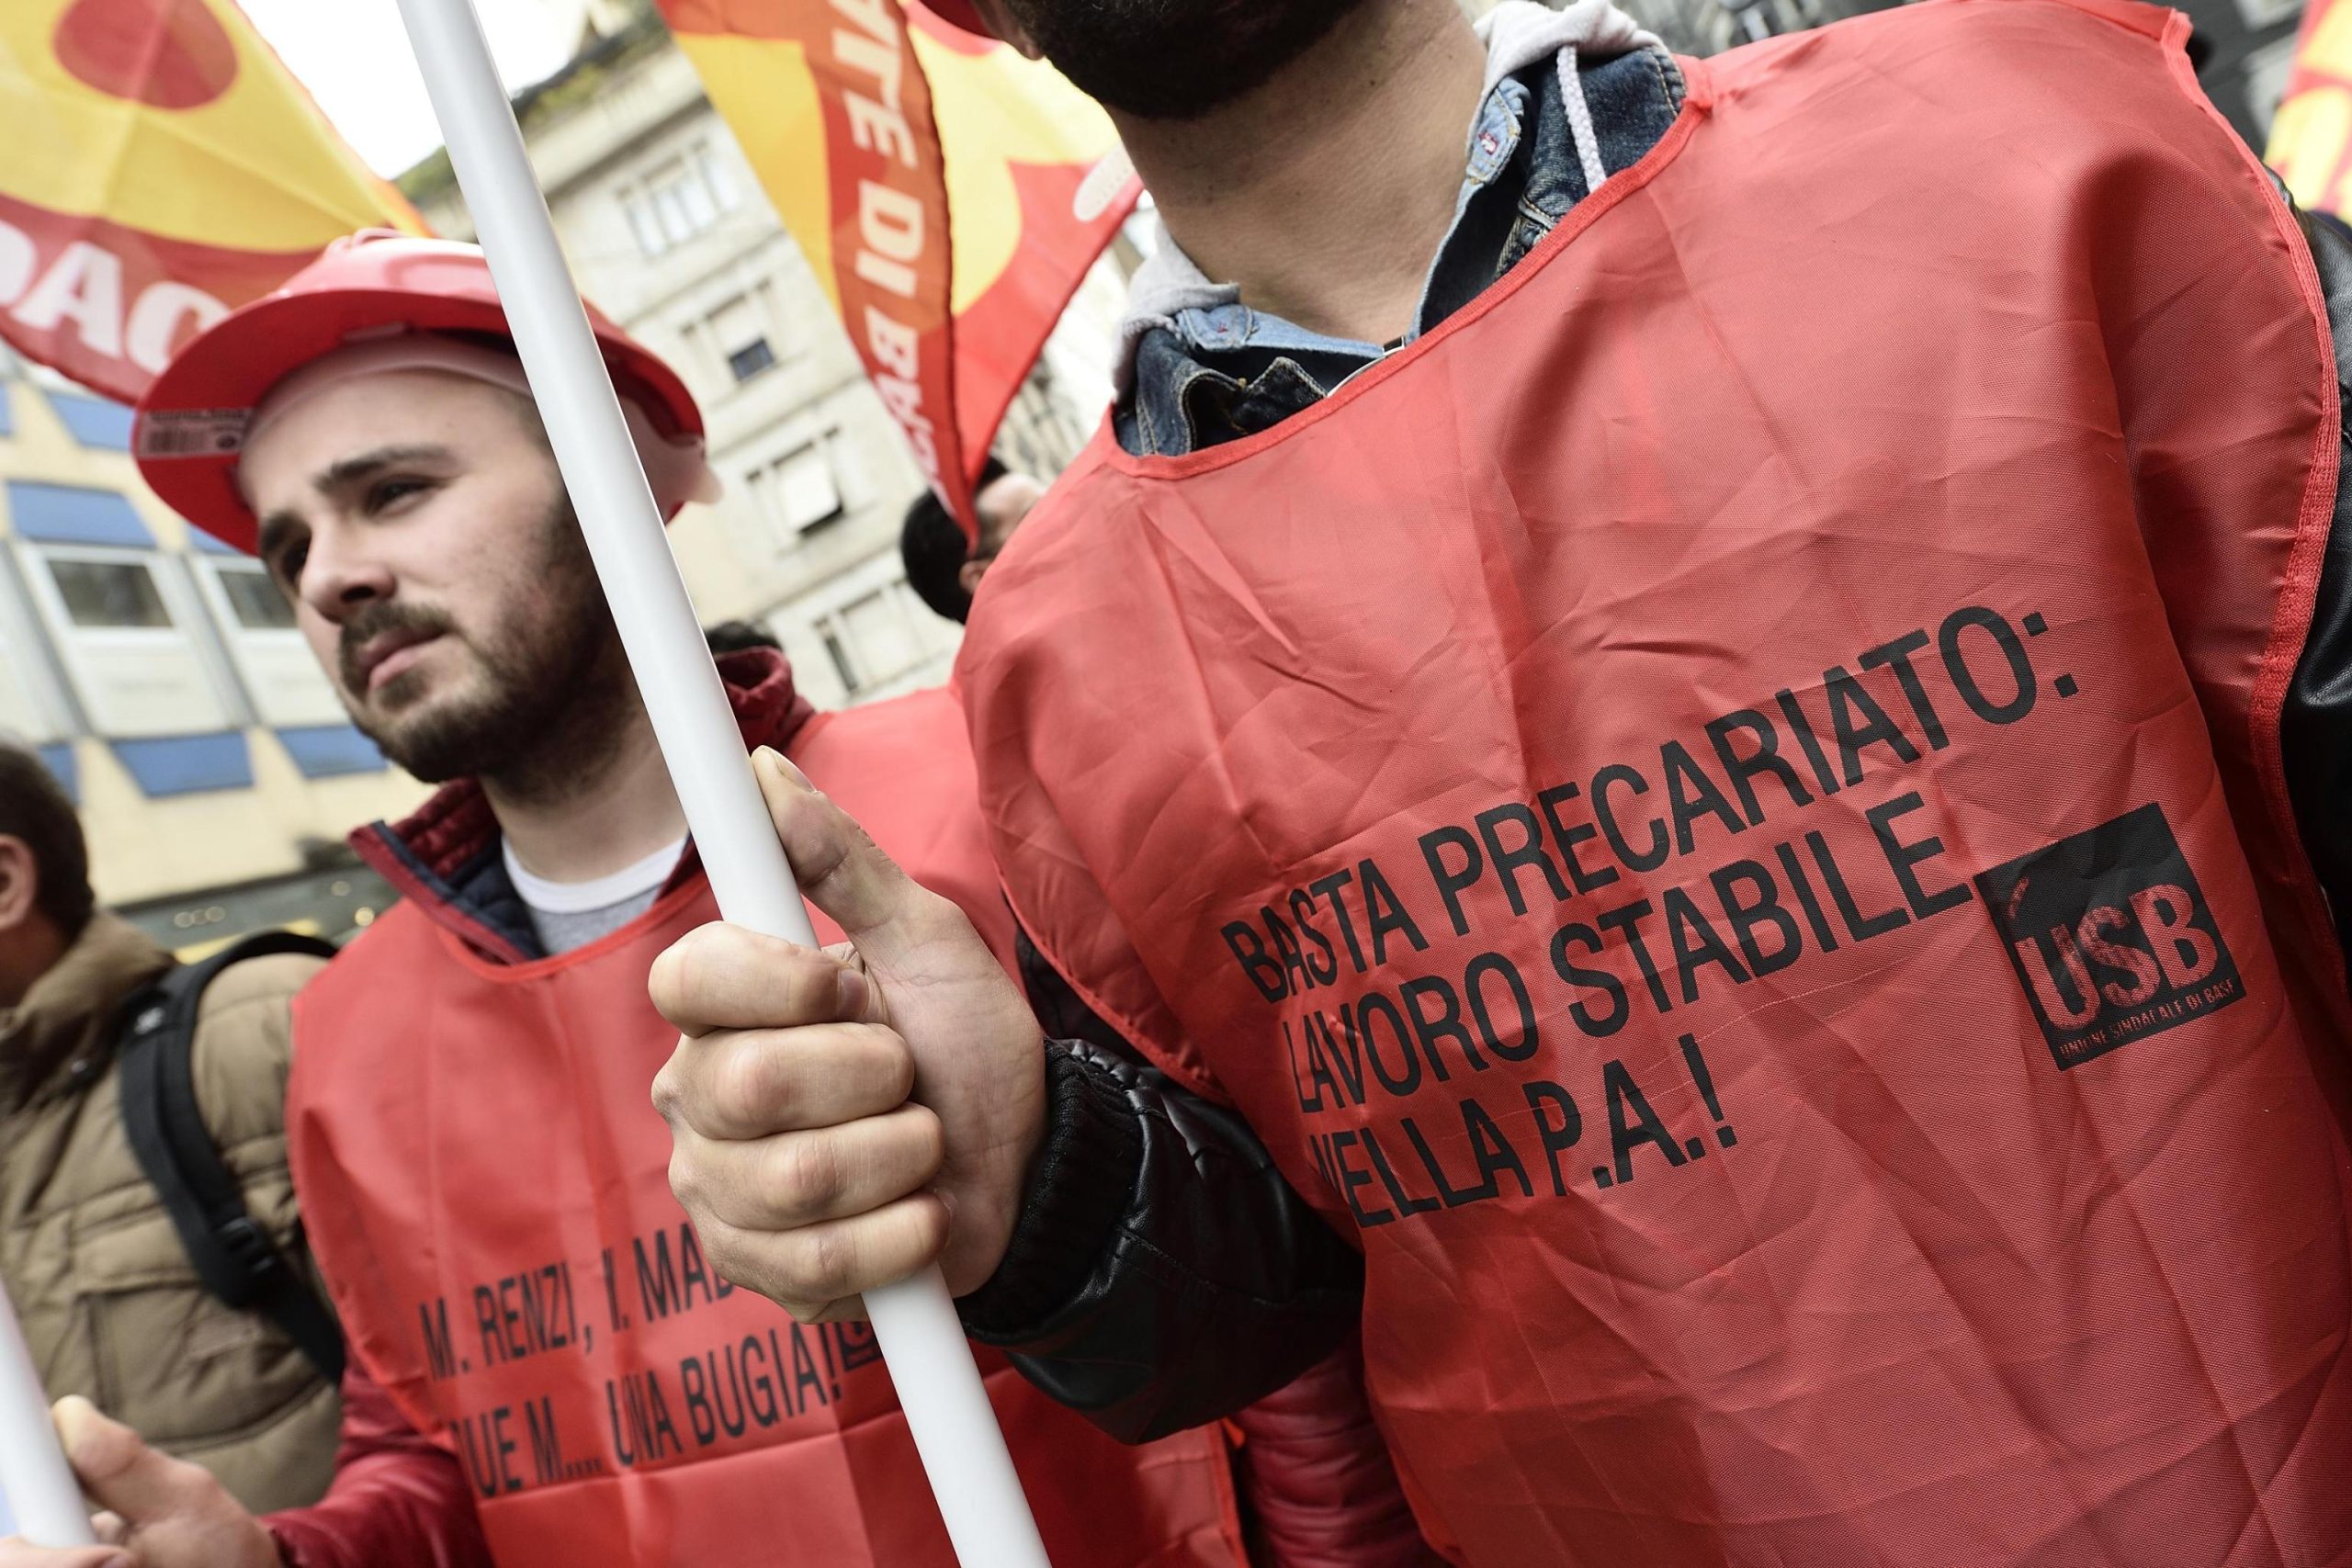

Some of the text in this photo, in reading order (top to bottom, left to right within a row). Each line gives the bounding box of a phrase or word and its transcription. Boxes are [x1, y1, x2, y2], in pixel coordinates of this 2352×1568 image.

[1220, 605, 2079, 1004] BASTA PRECARIATO:
[1283, 791, 1973, 1112] LAVORO STABILE
[2015, 883, 2220, 1031] USB
[2185, 992, 2203, 1010] DI
[473, 1259, 594, 1367] RENZI,
[449, 1406, 523, 1499] UE
[605, 1369, 683, 1467] UNA
[680, 1321, 842, 1447] BUGIA!
